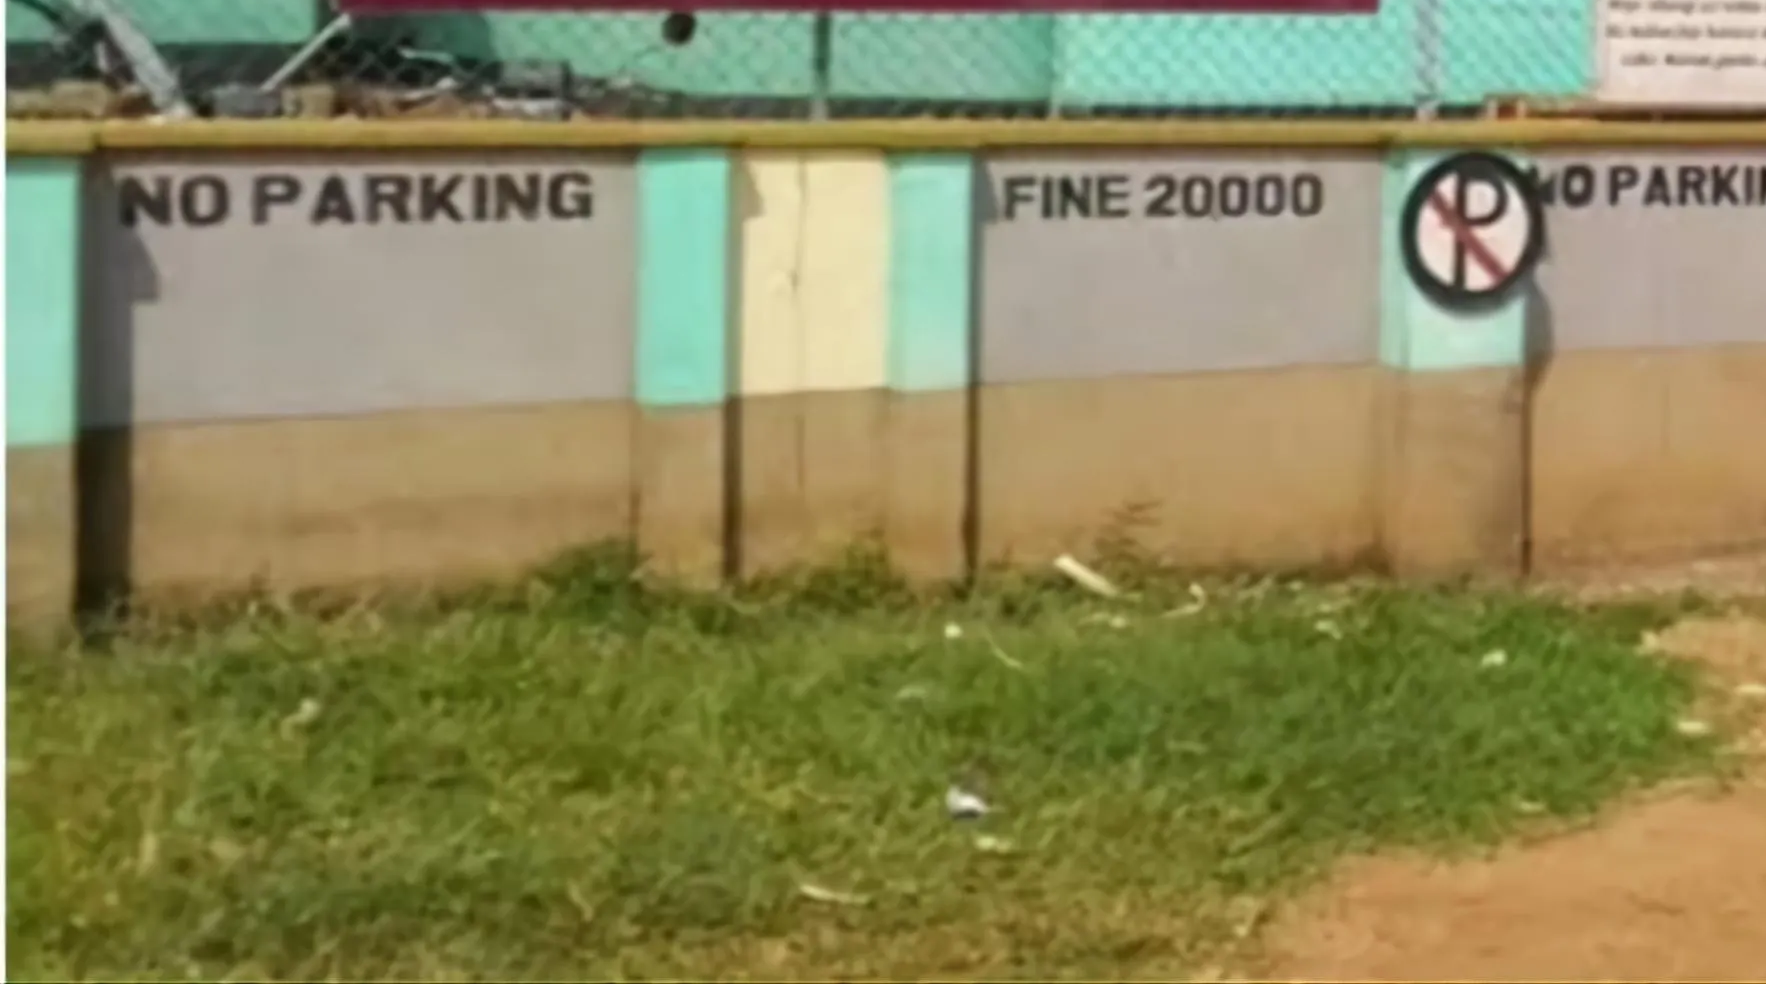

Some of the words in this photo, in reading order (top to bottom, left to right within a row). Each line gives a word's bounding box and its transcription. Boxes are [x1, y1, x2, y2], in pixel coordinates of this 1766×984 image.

[118, 174, 230, 228] NO
[251, 171, 594, 226] PARKING
[1002, 174, 1131, 221] FINE
[1143, 172, 1324, 219] 20000
